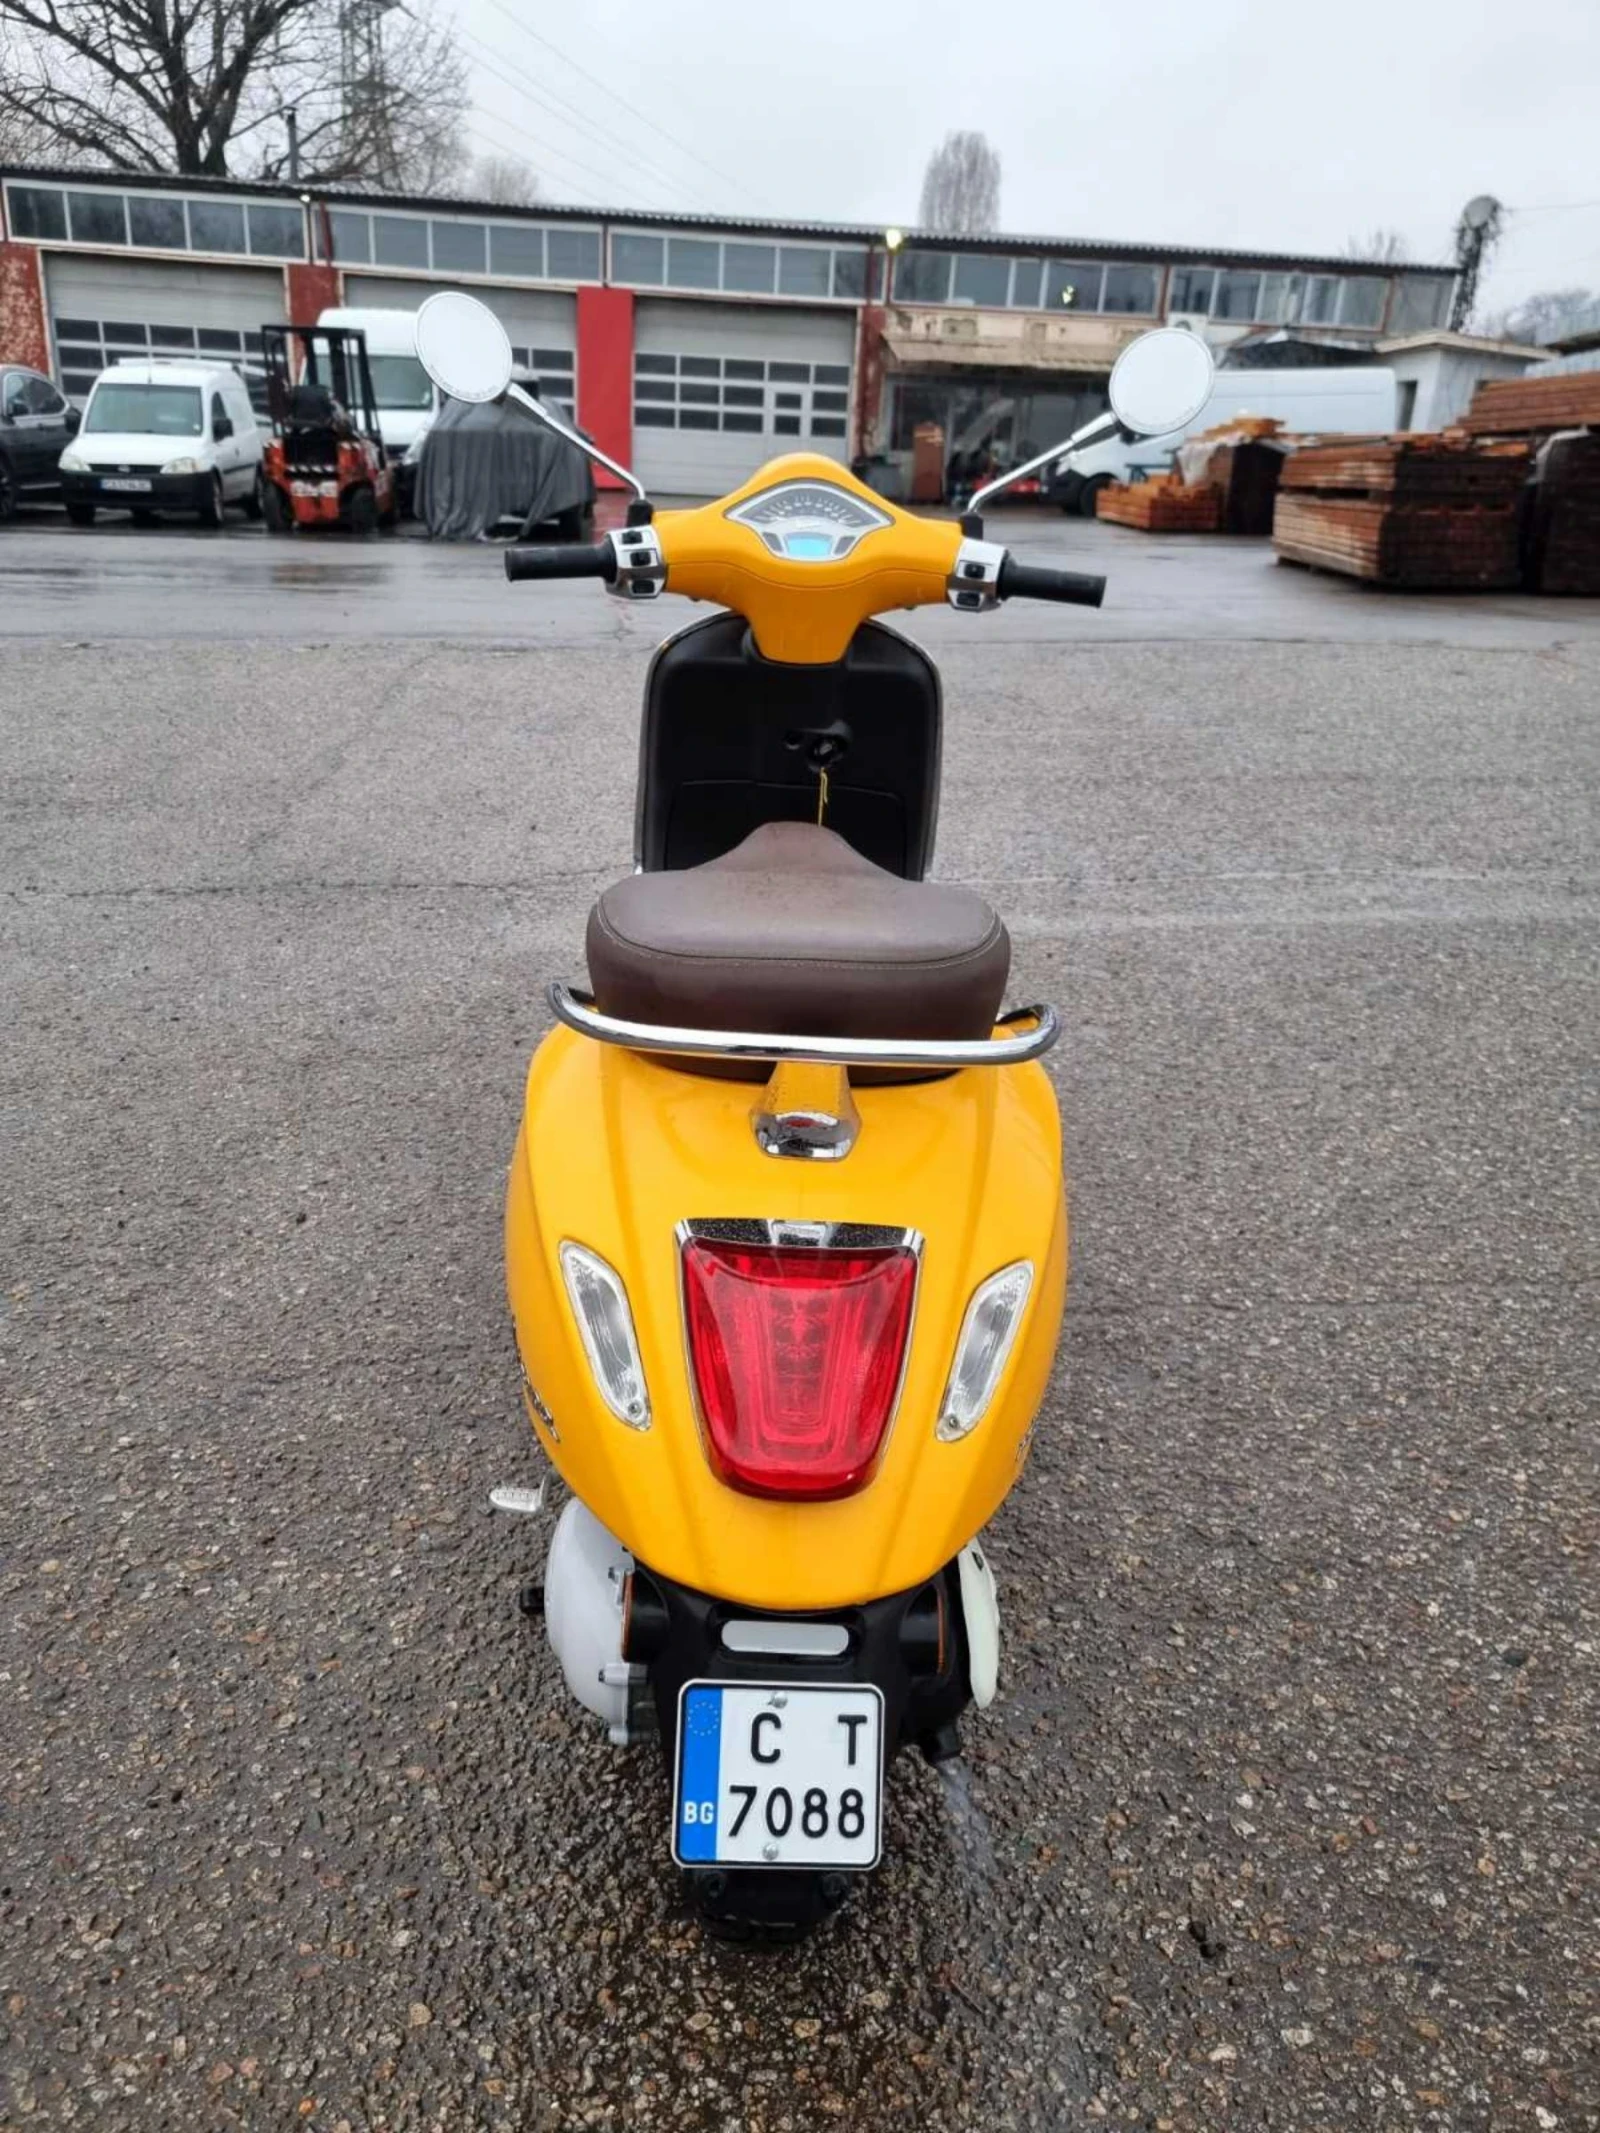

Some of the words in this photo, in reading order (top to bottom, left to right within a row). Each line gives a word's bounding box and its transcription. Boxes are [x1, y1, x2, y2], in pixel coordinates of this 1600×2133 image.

[750, 1712, 782, 1764] C
[837, 1714, 868, 1766] T
[683, 1801, 714, 1825] BG
[728, 1785, 865, 1839] 7088
